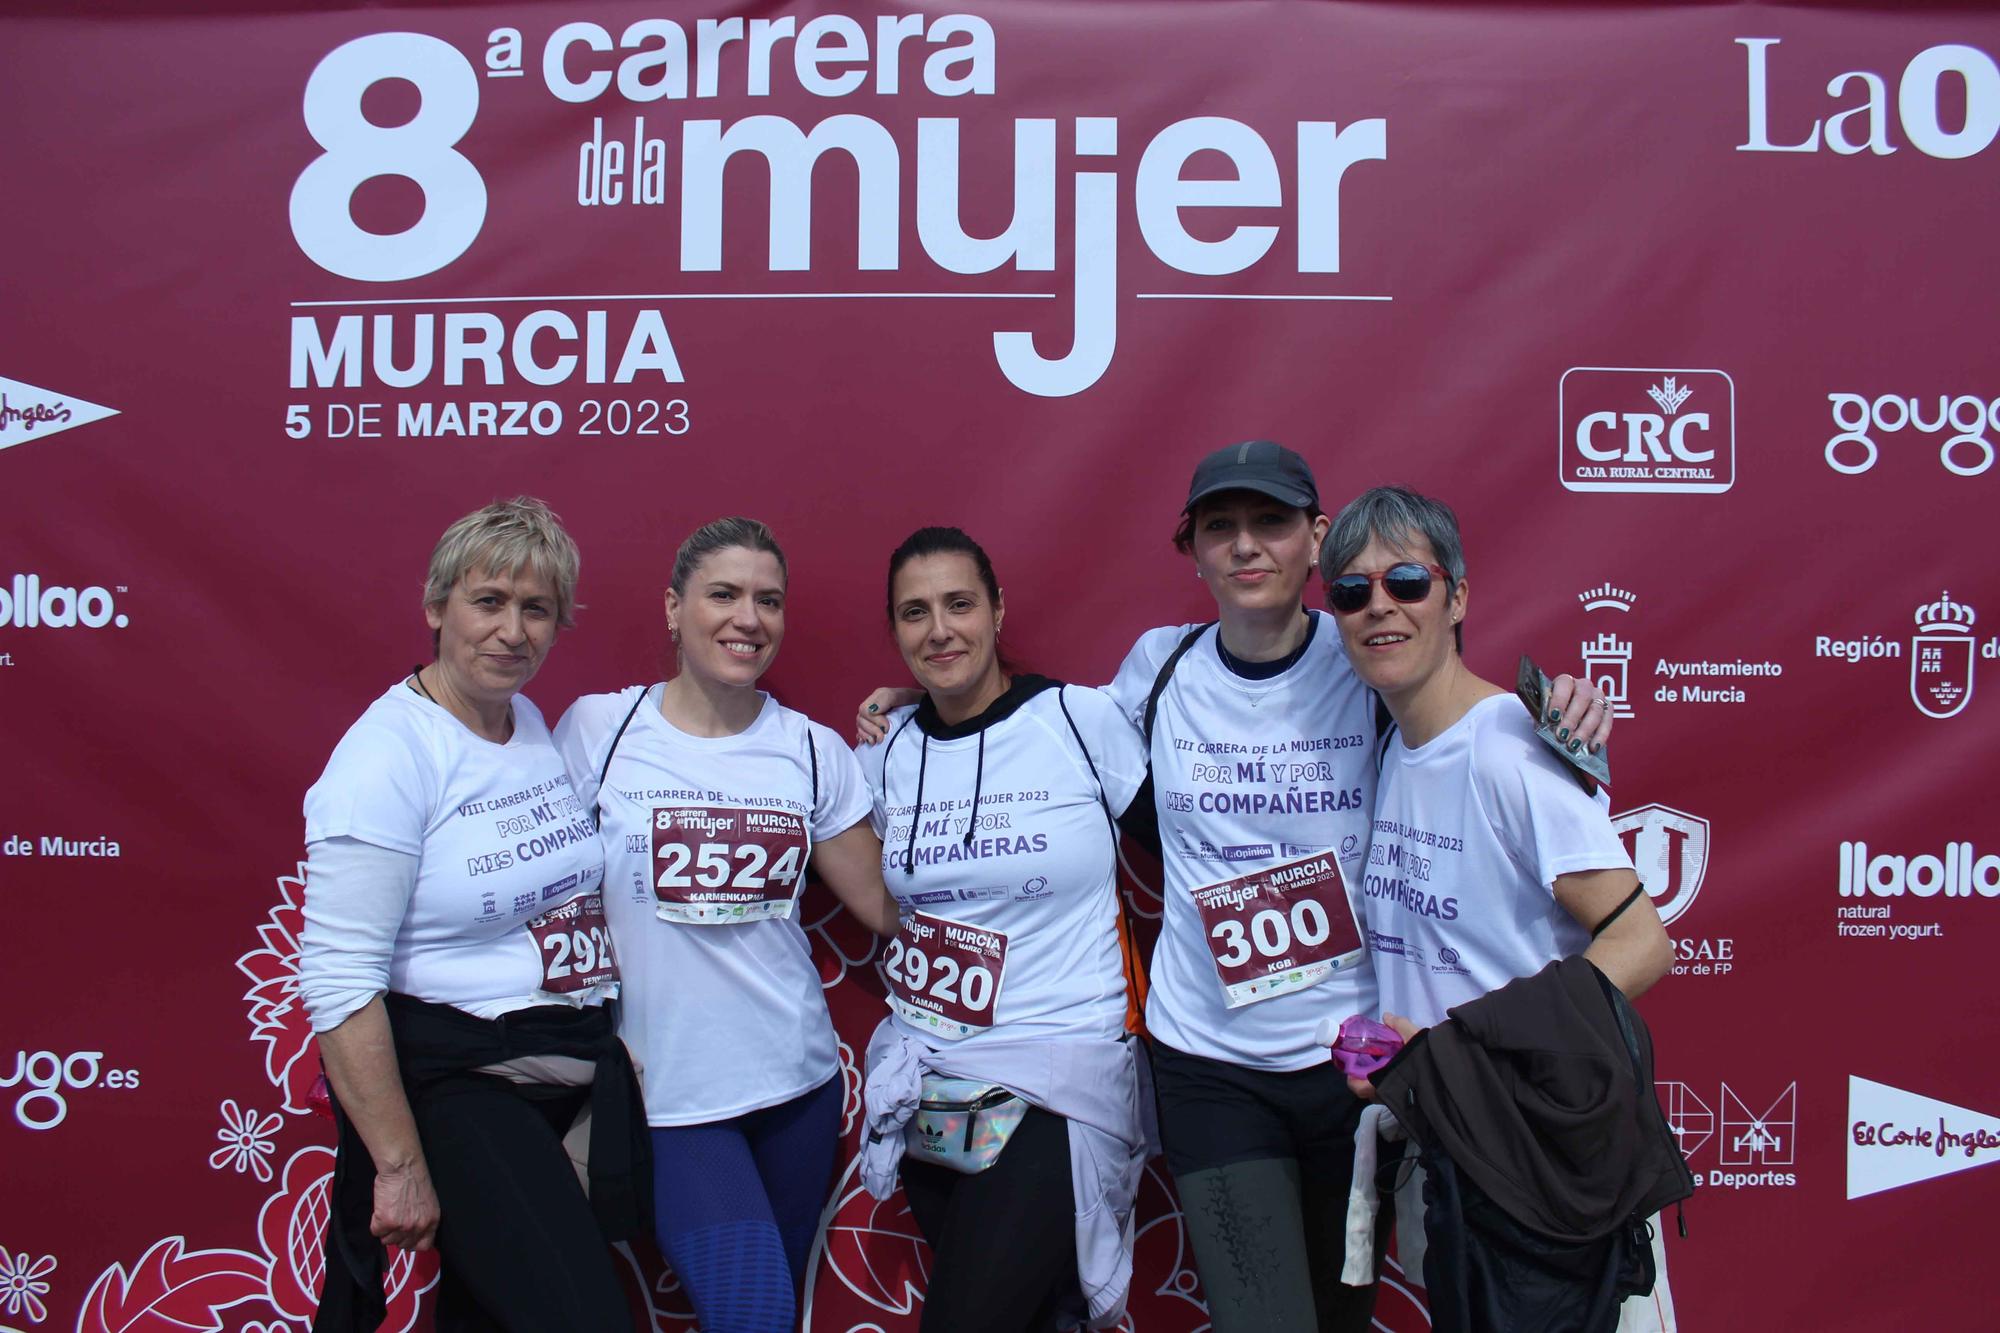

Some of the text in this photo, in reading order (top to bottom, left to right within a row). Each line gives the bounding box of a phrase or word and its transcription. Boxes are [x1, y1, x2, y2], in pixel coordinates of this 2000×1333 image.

[542, 14, 995, 102] carrera
[576, 114, 1386, 397] de la mujer
[289, 309, 685, 389] MURCIA
[284, 400, 691, 439] 5 DE MARZO 2023
[1576, 411, 1715, 463] CRC
[1576, 467, 1715, 479] CAJA RURAL CENTRAL
[1815, 635, 1901, 663] Región
[1655, 658, 1782, 679] Ayuntamiento
[1655, 686, 1746, 704] de Murcia
[1198, 742, 1248, 755] CARRERA
[1252, 745, 1268, 755] DE
[1272, 742, 1287, 754] LA
[1291, 738, 1332, 752] MUJER
[1333, 734, 1364, 750] 2023
[1192, 756, 1334, 784] POR MÍ Y POR
[459, 804, 485, 817] VIII
[488, 789, 532, 811] CARRERA
[532, 784, 545, 797] DE
[544, 780, 556, 793] LA
[647, 790, 704, 801] CARRERA
[707, 791, 724, 802] DE
[744, 797, 784, 807] MUJER
[940, 800, 954, 812] DE
[958, 798, 971, 809] LA
[1018, 790, 1050, 802] 2023
[1166, 786, 1363, 815] MIS COMPAÑERAS
[496, 814, 535, 838] POR
[530, 796, 557, 826] MÍ
[684, 817, 734, 838] mujer
[746, 813, 801, 829] MURCIA
[922, 813, 951, 838] MÍ
[954, 817, 968, 835] Y
[3, 836, 121, 857] de Murcia
[1370, 843, 1385, 865] OR
[1437, 835, 1464, 853] 2023
[467, 850, 514, 876] MIS
[656, 842, 800, 889] 2524
[1270, 859, 1332, 886] MURCIA
[1290, 878, 1316, 890] MARZO
[1317, 871, 1335, 882] 2023
[1198, 885, 1232, 900] carrera
[1210, 883, 1260, 912] mujer
[1838, 905, 1891, 920] natural
[945, 926, 1001, 950] MURCIA
[1211, 899, 1330, 968] 300
[1838, 921, 1943, 940] frozen yogurt.
[958, 943, 983, 954] MARZO
[885, 937, 994, 1012] 2920
[1267, 959, 1292, 973] KGB
[1692, 963, 1711, 975] de
[1714, 963, 1732, 975] FP
[910, 995, 944, 1013] TAMARA
[1852, 1121, 1876, 1146] El
[1878, 1123, 1932, 1147] Corte
[1710, 1170, 1796, 1190] Deportes
